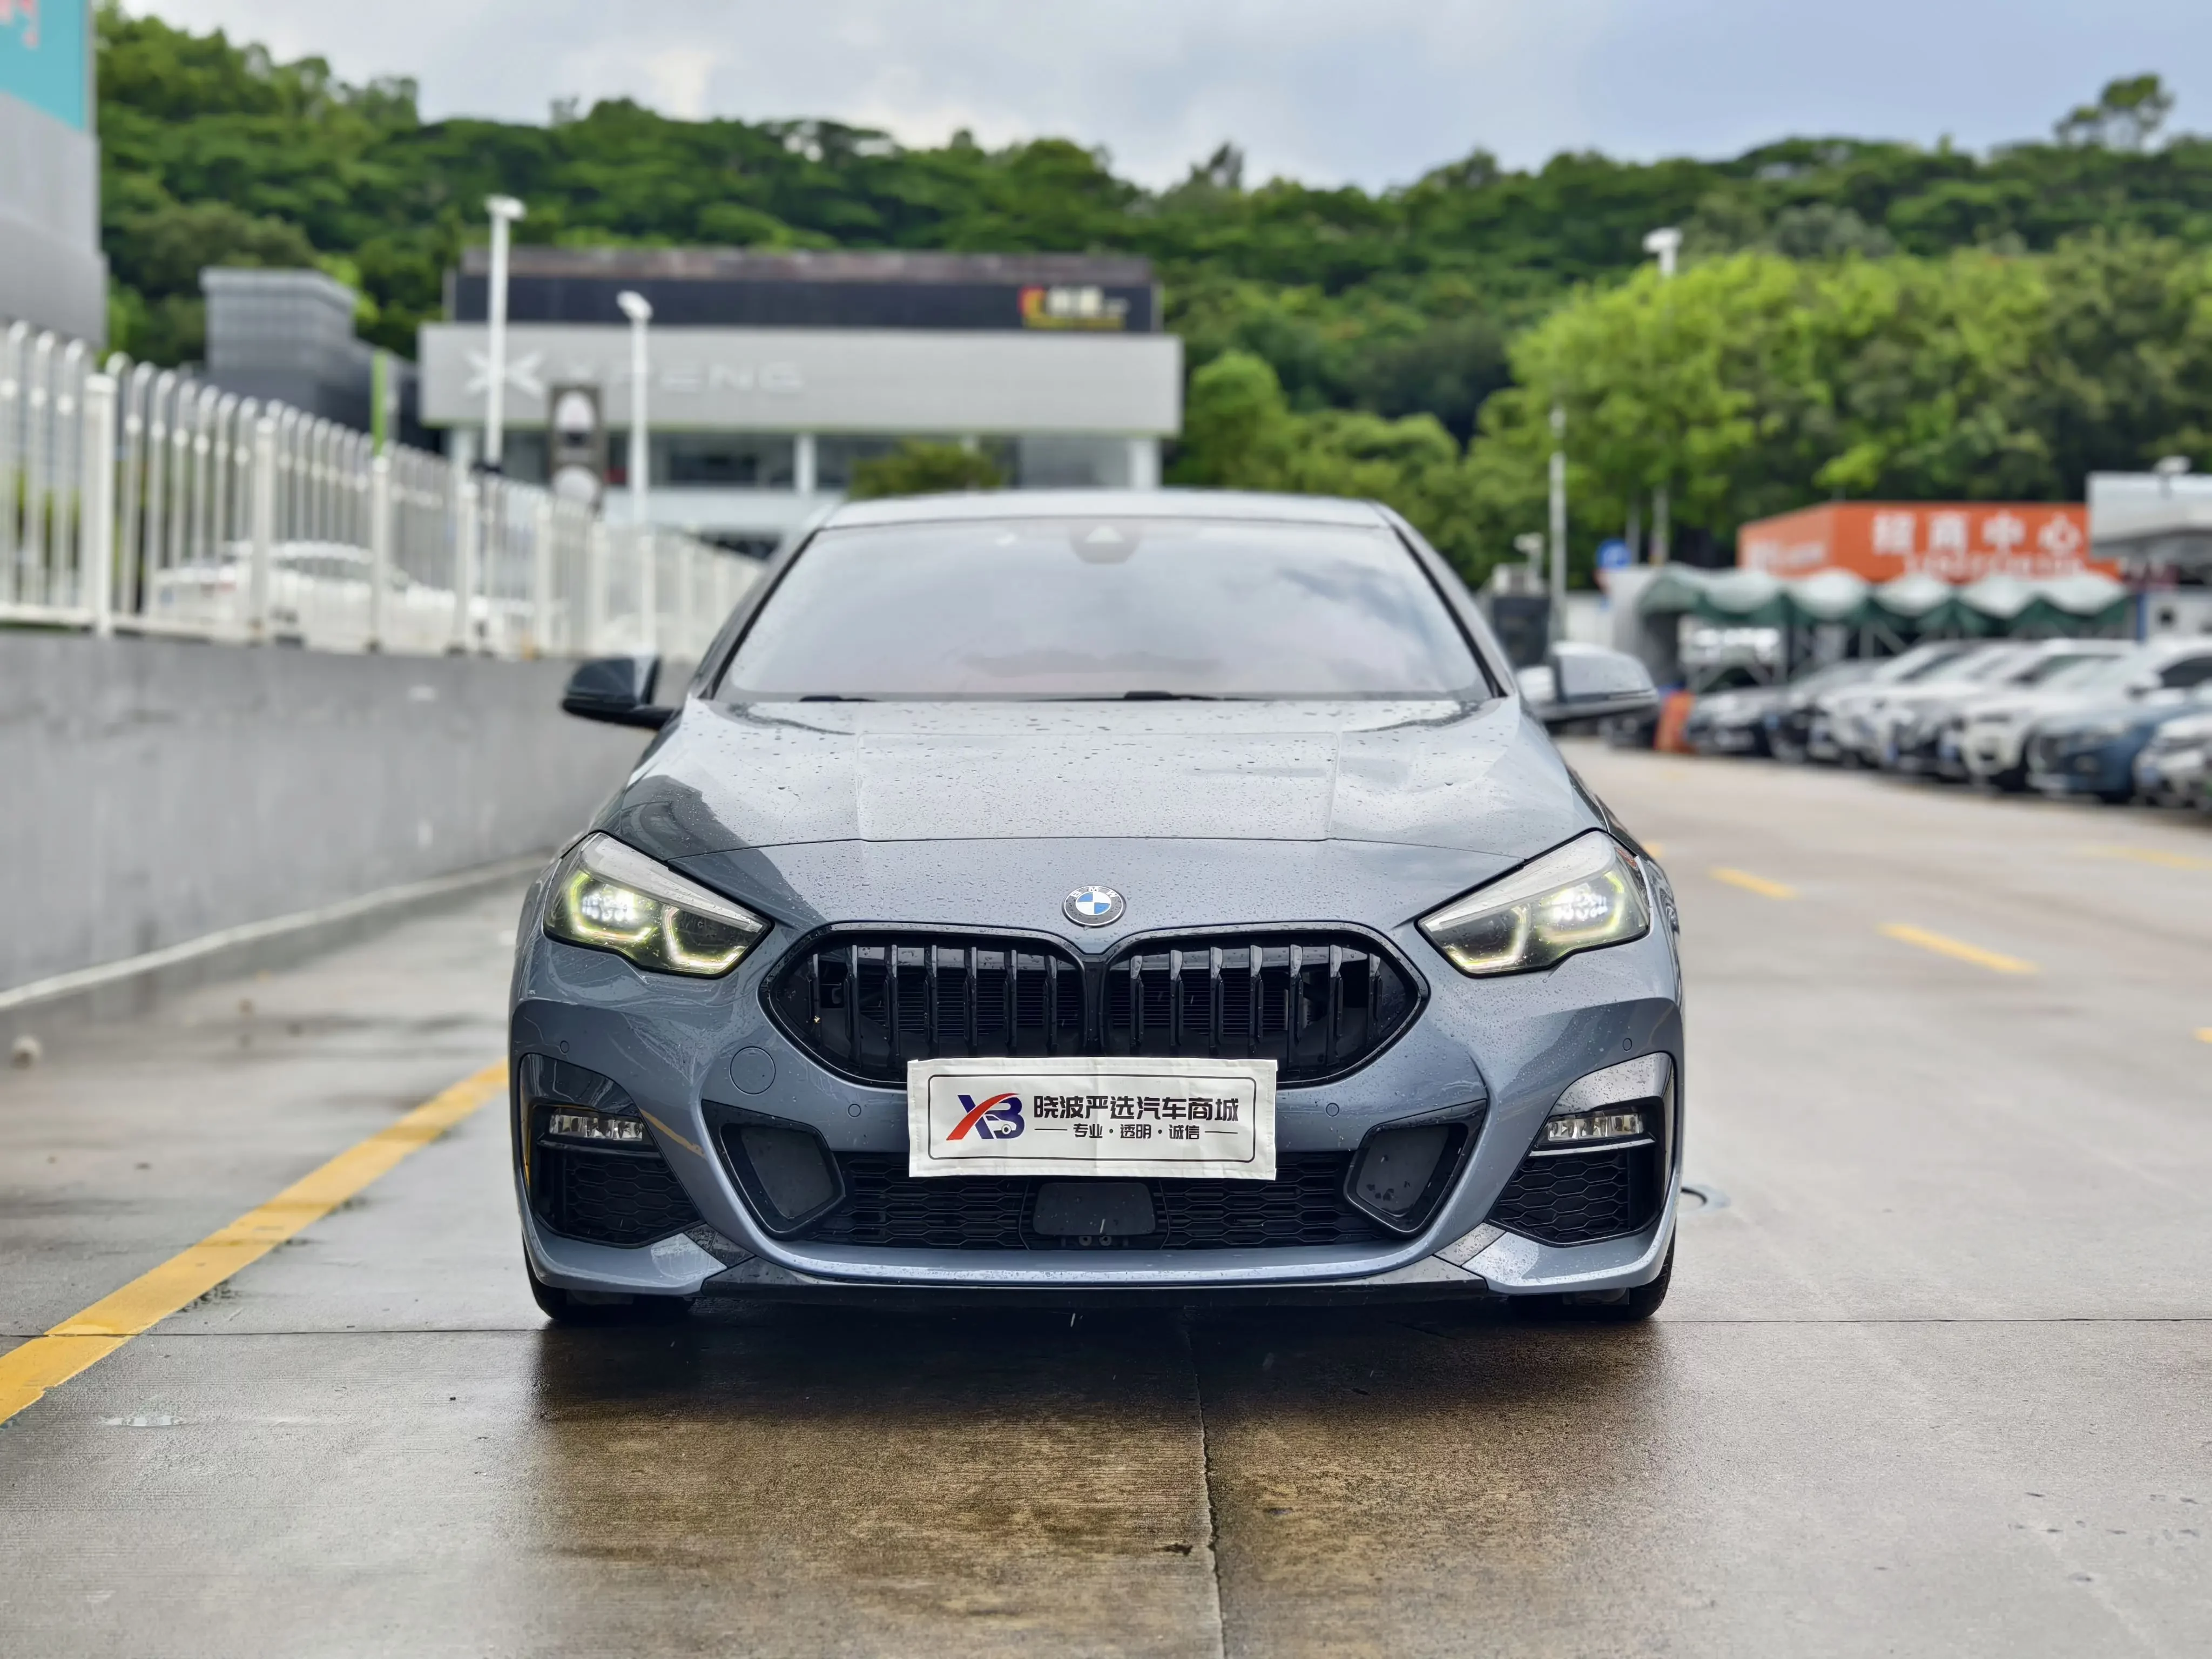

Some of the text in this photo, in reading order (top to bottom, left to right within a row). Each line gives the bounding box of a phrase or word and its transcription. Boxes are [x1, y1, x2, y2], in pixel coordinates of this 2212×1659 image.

[1070, 886, 1118, 898] BMW
[1033, 1095, 1239, 1122] 晓波严选汽车商城
